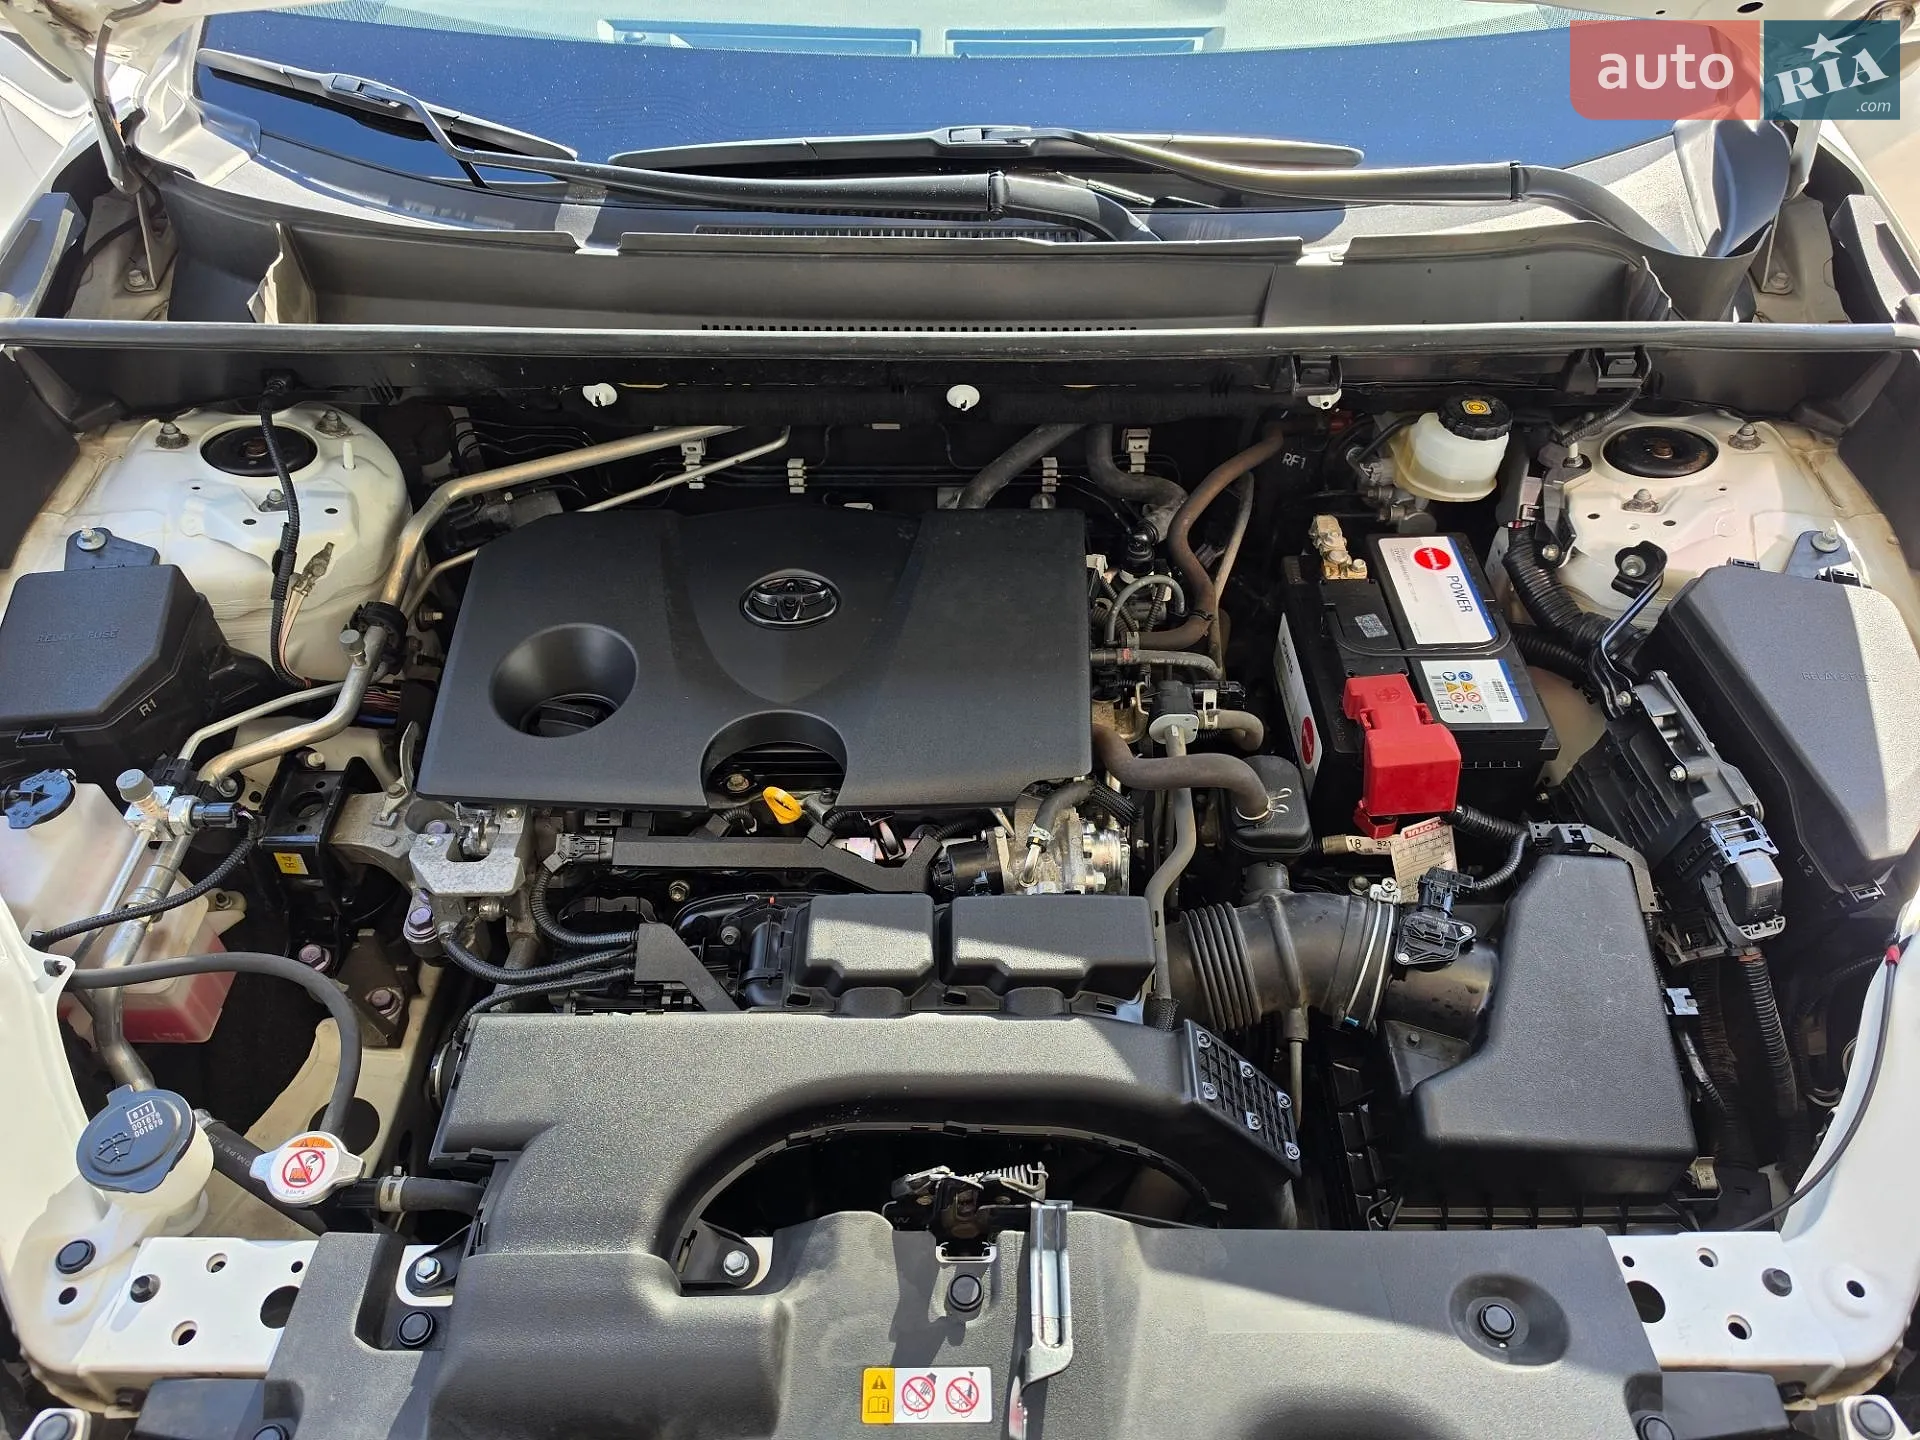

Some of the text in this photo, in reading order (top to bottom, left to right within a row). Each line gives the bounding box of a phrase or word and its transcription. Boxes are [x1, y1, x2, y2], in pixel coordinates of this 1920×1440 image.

[1446, 575, 1473, 613] POWER
[139, 699, 157, 717] R1
[1405, 820, 1441, 838] MOTUL
[1349, 838, 1361, 849] 18
